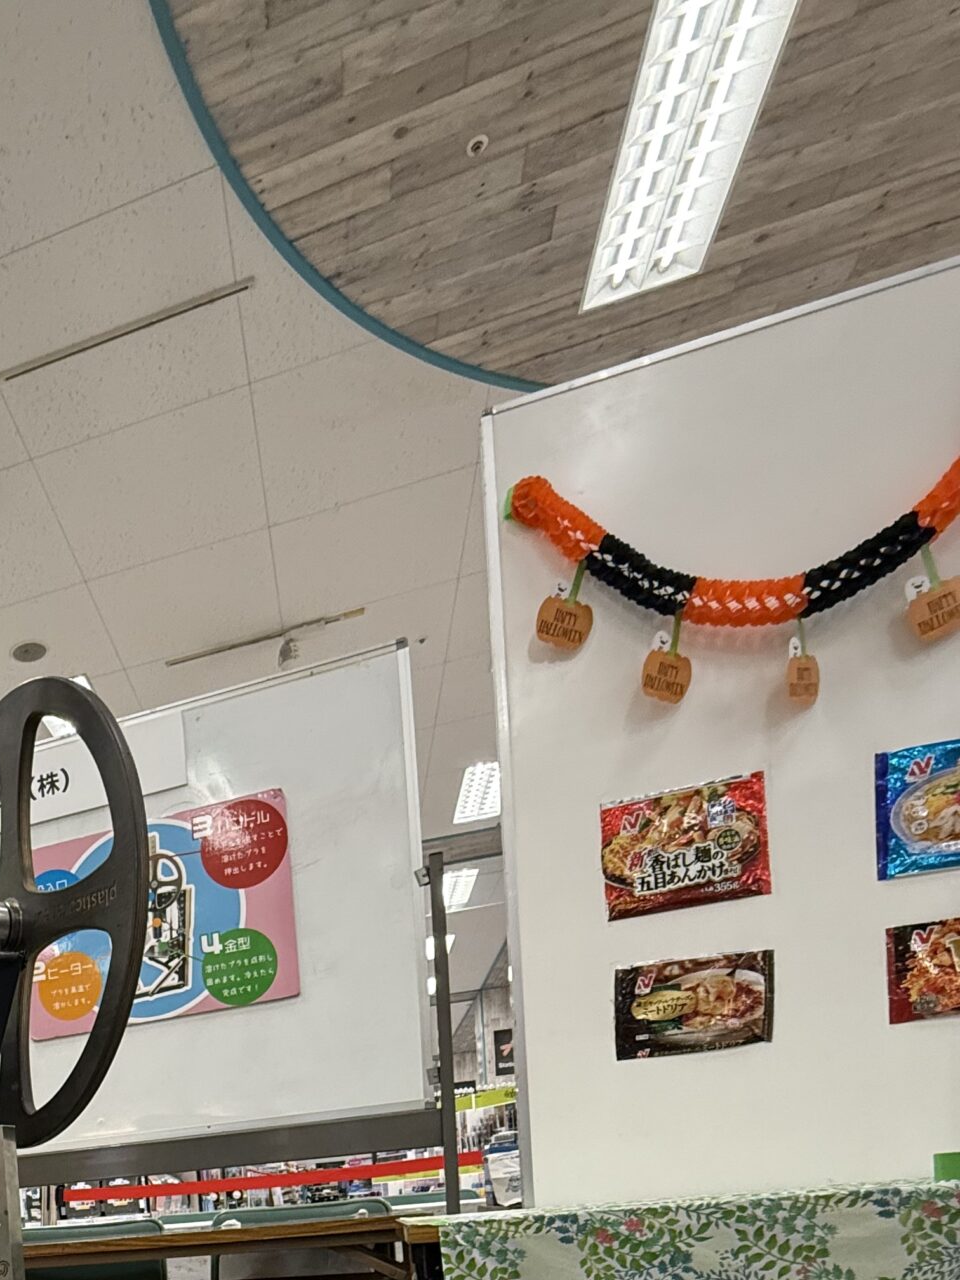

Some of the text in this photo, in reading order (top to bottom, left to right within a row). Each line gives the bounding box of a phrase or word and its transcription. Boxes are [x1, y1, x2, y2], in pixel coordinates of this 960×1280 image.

[637, 861, 725, 893] 五目あんかけ
[201, 932, 251, 955] 4 金型
[47, 962, 93, 980] ヒーター
[642, 1003, 688, 1016] ミートドリア
